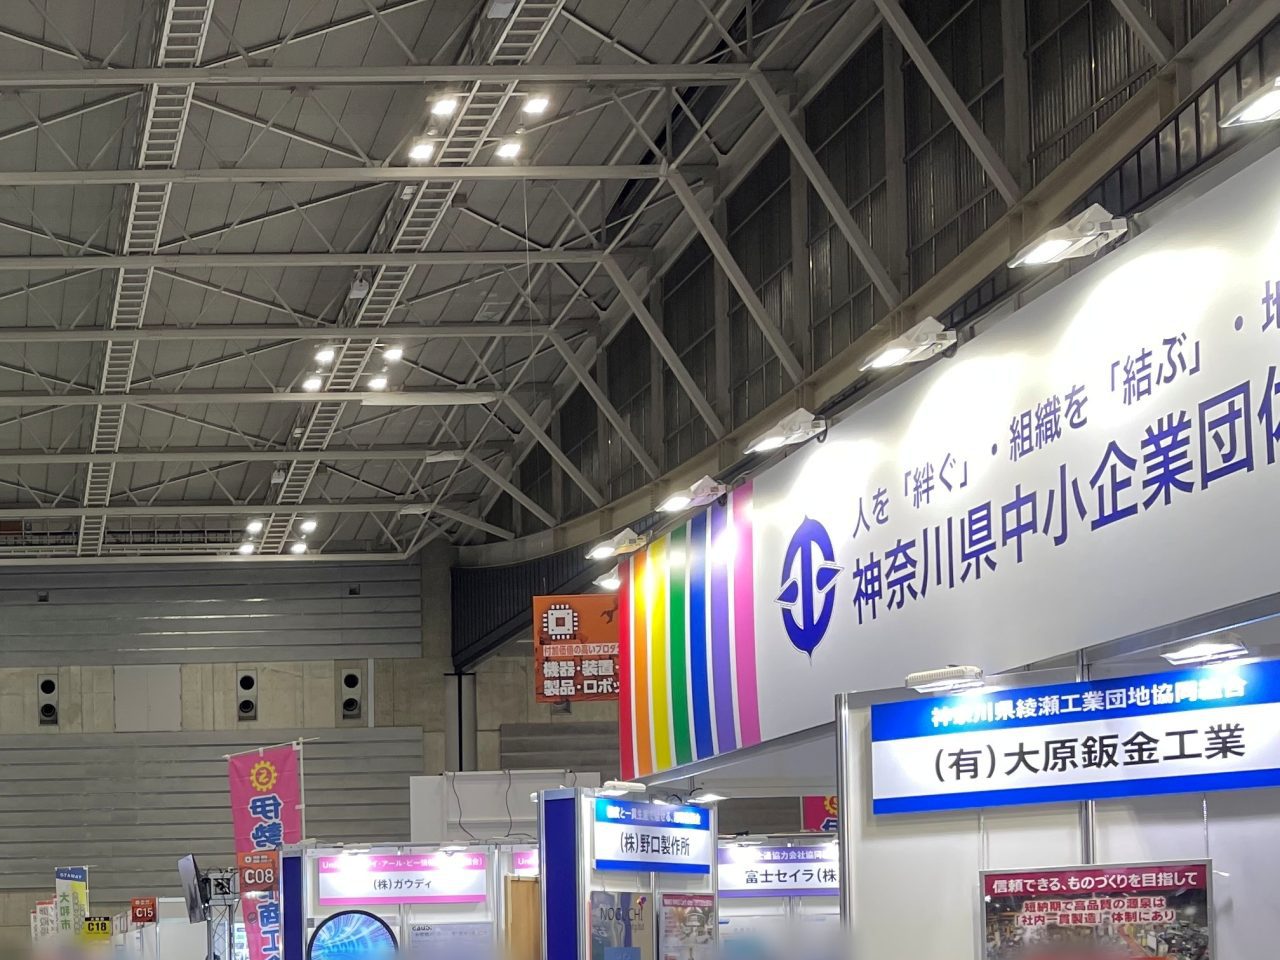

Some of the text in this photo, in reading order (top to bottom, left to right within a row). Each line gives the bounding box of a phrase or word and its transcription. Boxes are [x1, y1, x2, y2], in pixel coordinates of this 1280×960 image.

[934, 723, 1246, 782] (有)大原鈑金工業
[620, 832, 690, 856] (株)野口製作所
[245, 868, 274, 884] C08
[992, 871, 1198, 894] 信頼できる、ものづくりを目指して
[373, 879, 432, 890] (株)ガウディ
[136, 908, 153, 917] C15
[1024, 897, 1166, 913] 短納期で高品質の源泉は
[88, 922, 107, 931] C18
